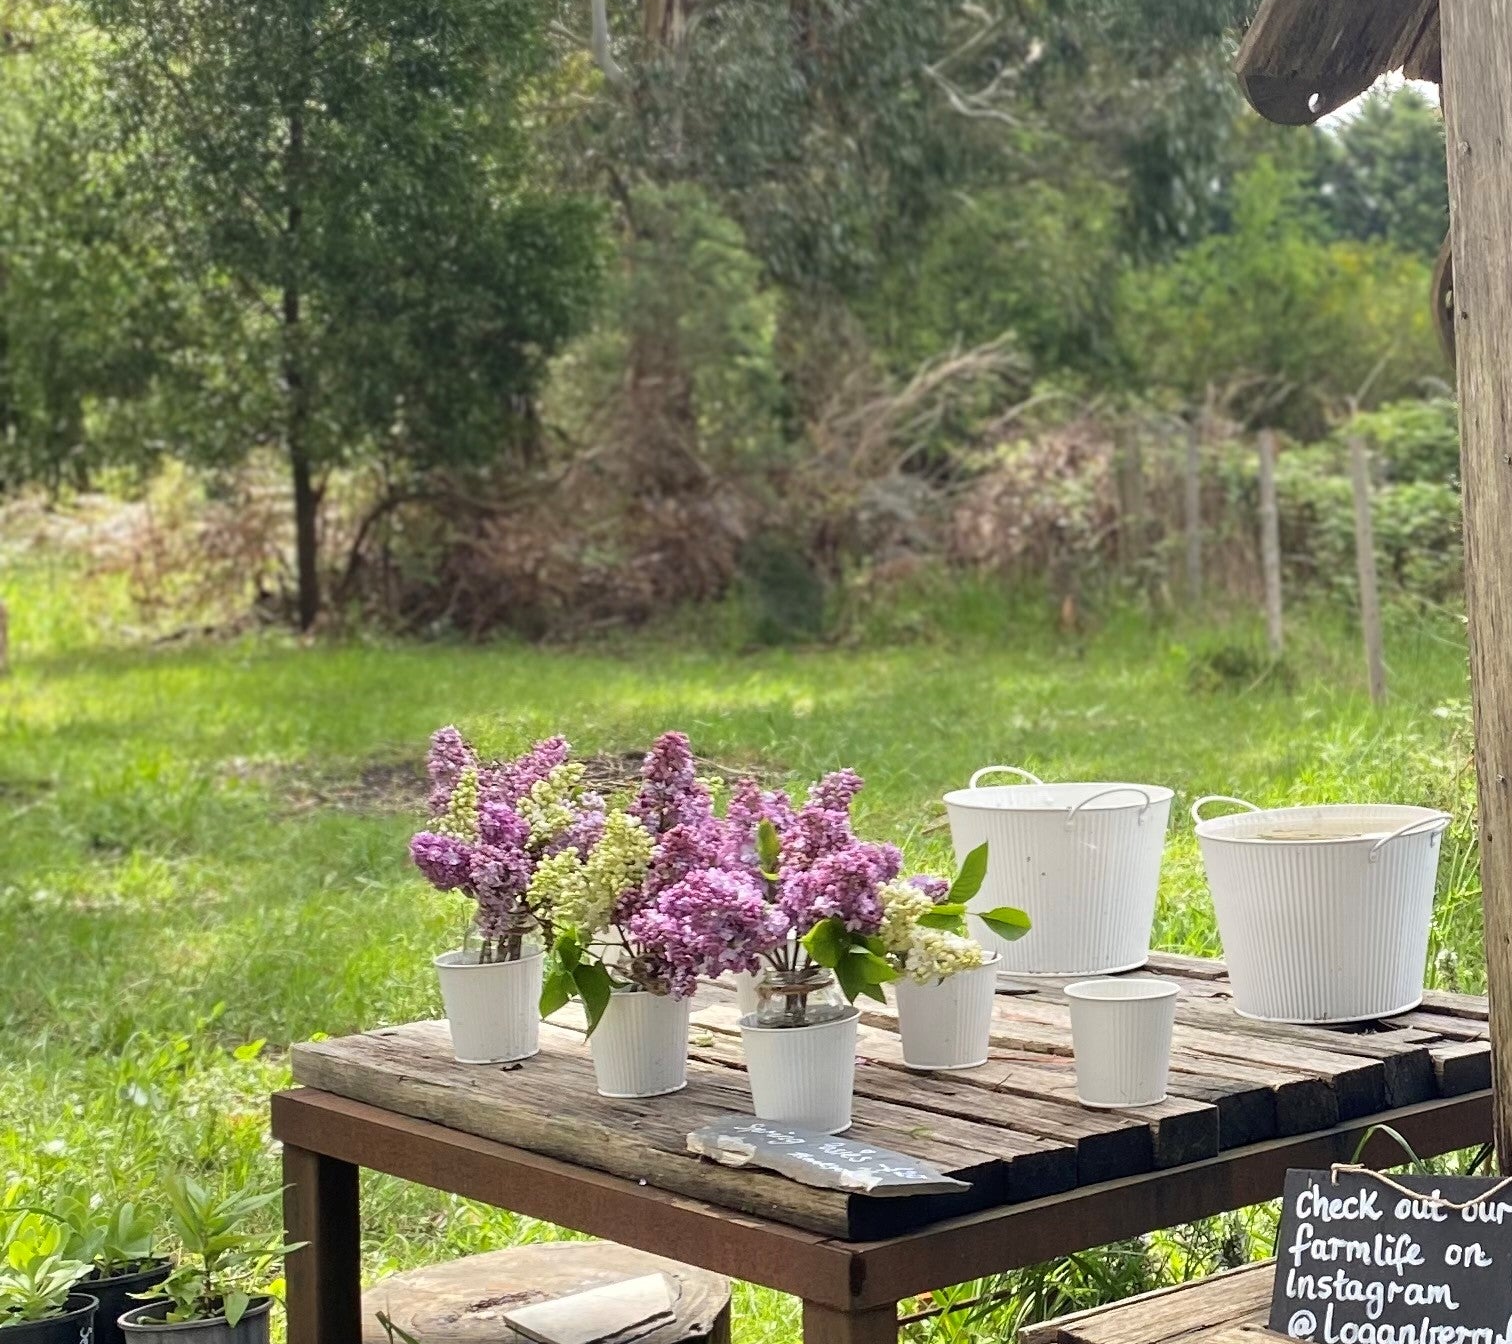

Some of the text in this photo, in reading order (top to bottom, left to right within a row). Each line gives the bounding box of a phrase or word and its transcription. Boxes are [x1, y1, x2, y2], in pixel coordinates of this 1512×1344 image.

[1394, 1189, 1448, 1223] out
[1288, 1222, 1493, 1276] farmlife on
[1285, 1268, 1460, 1320] Instagram
